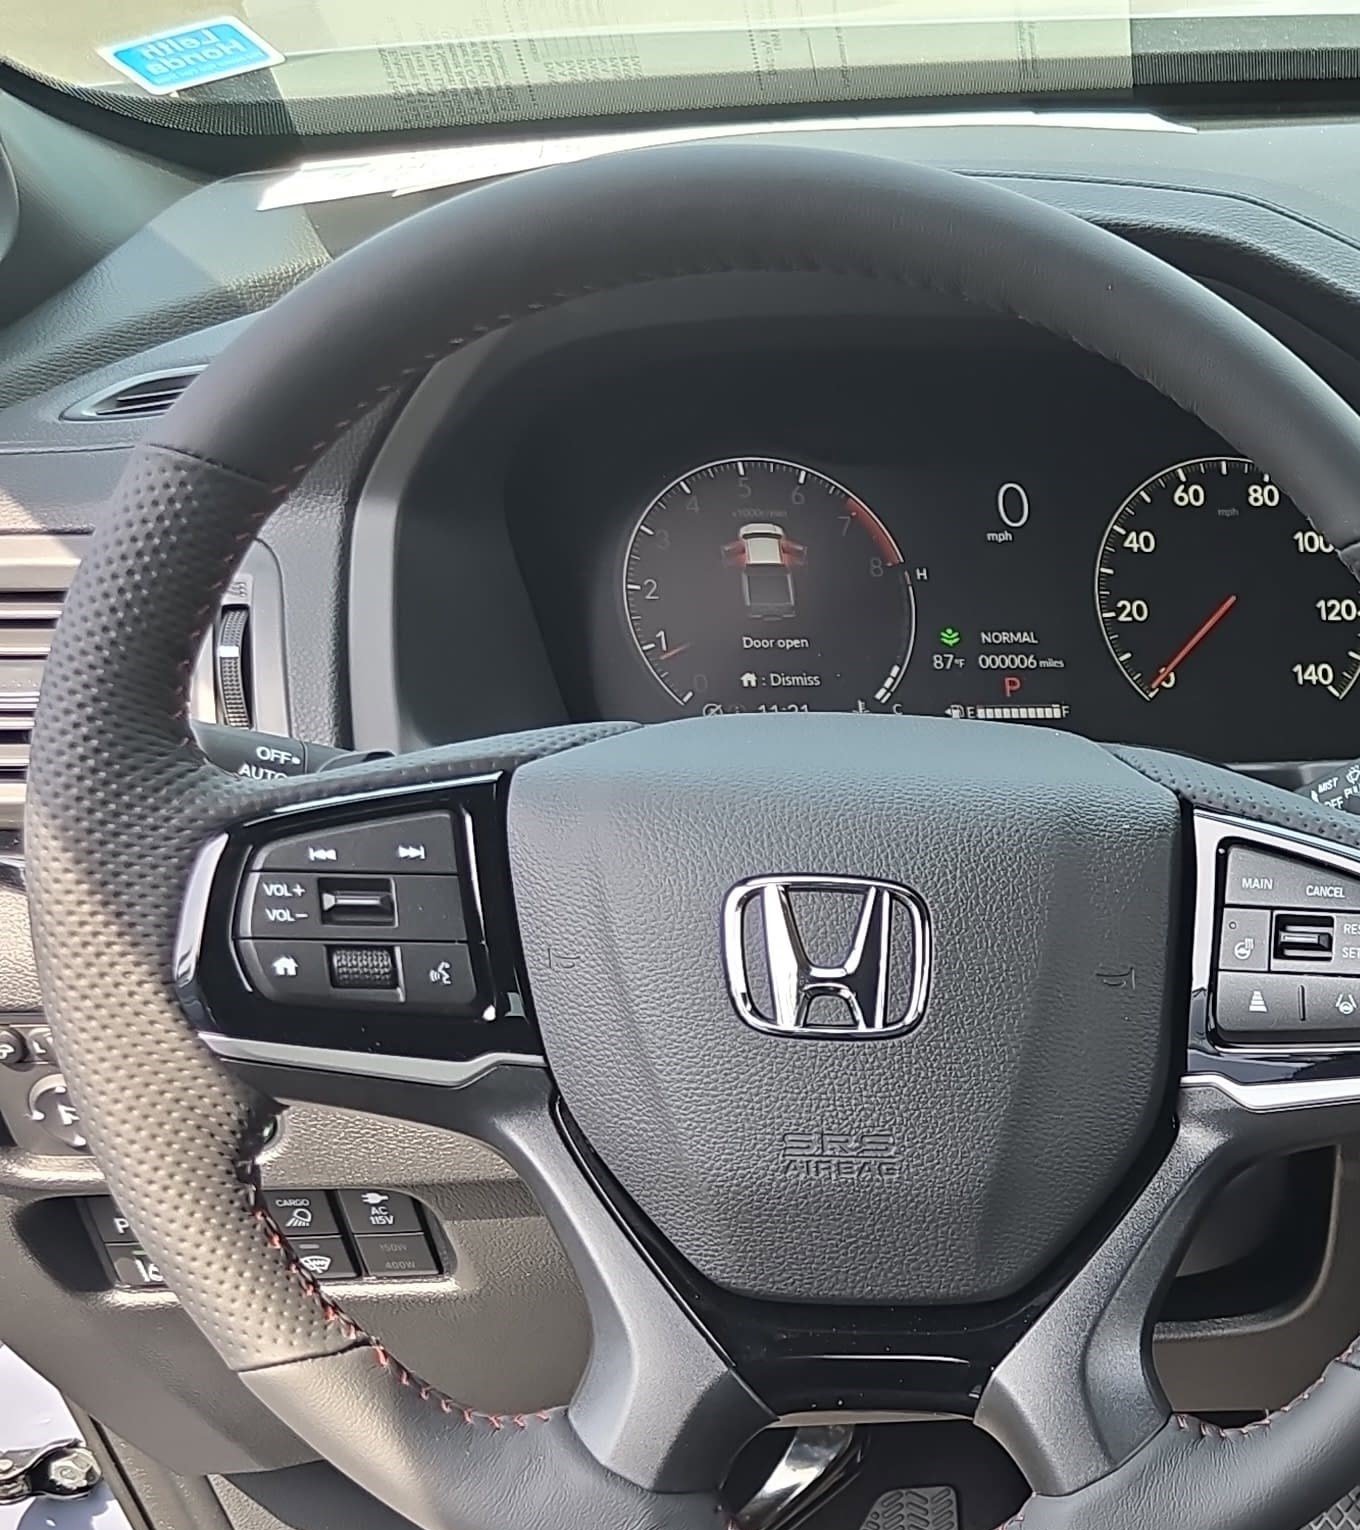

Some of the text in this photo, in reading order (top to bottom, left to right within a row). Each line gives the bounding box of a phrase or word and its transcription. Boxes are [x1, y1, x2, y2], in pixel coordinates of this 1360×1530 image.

[739, 481, 750, 497] 5
[792, 487, 805, 504] 6
[1174, 484, 1205, 507] 60
[1248, 484, 1280, 507] 80
[686, 495, 699, 512] 4
[998, 482, 1029, 527] 0
[1218, 507, 1240, 518] mph
[837, 516, 851, 535] 7
[657, 529, 670, 550] 3
[987, 531, 1013, 543] mph
[1124, 531, 1156, 552] 40
[916, 568, 928, 581] H
[643, 580, 659, 600] 2
[1116, 600, 1149, 622] 20
[1315, 600, 1357, 621] 120
[655, 631, 667, 650] 1
[743, 636, 809, 651] Door open
[981, 632, 1038, 644] NORMAL
[979, 655, 1064, 669] 000006 miles
[770, 673, 820, 687] Dismiss
[1292, 663, 1333, 685] 140
[1005, 677, 1021, 697] P
[967, 707, 975, 718] E
[1062, 706, 1070, 718] F
[256, 747, 291, 764] OFF
[1318, 777, 1339, 793] MIST
[1242, 877, 1273, 890] MAIN
[1306, 885, 1345, 898] CANCEL
[783, 1132, 895, 1155] SRS
[784, 1160, 896, 1177] AIRBAG
[275, 1199, 309, 1207] CARGO
[371, 1207, 388, 1215] AC
[369, 1216, 394, 1224] 115V
